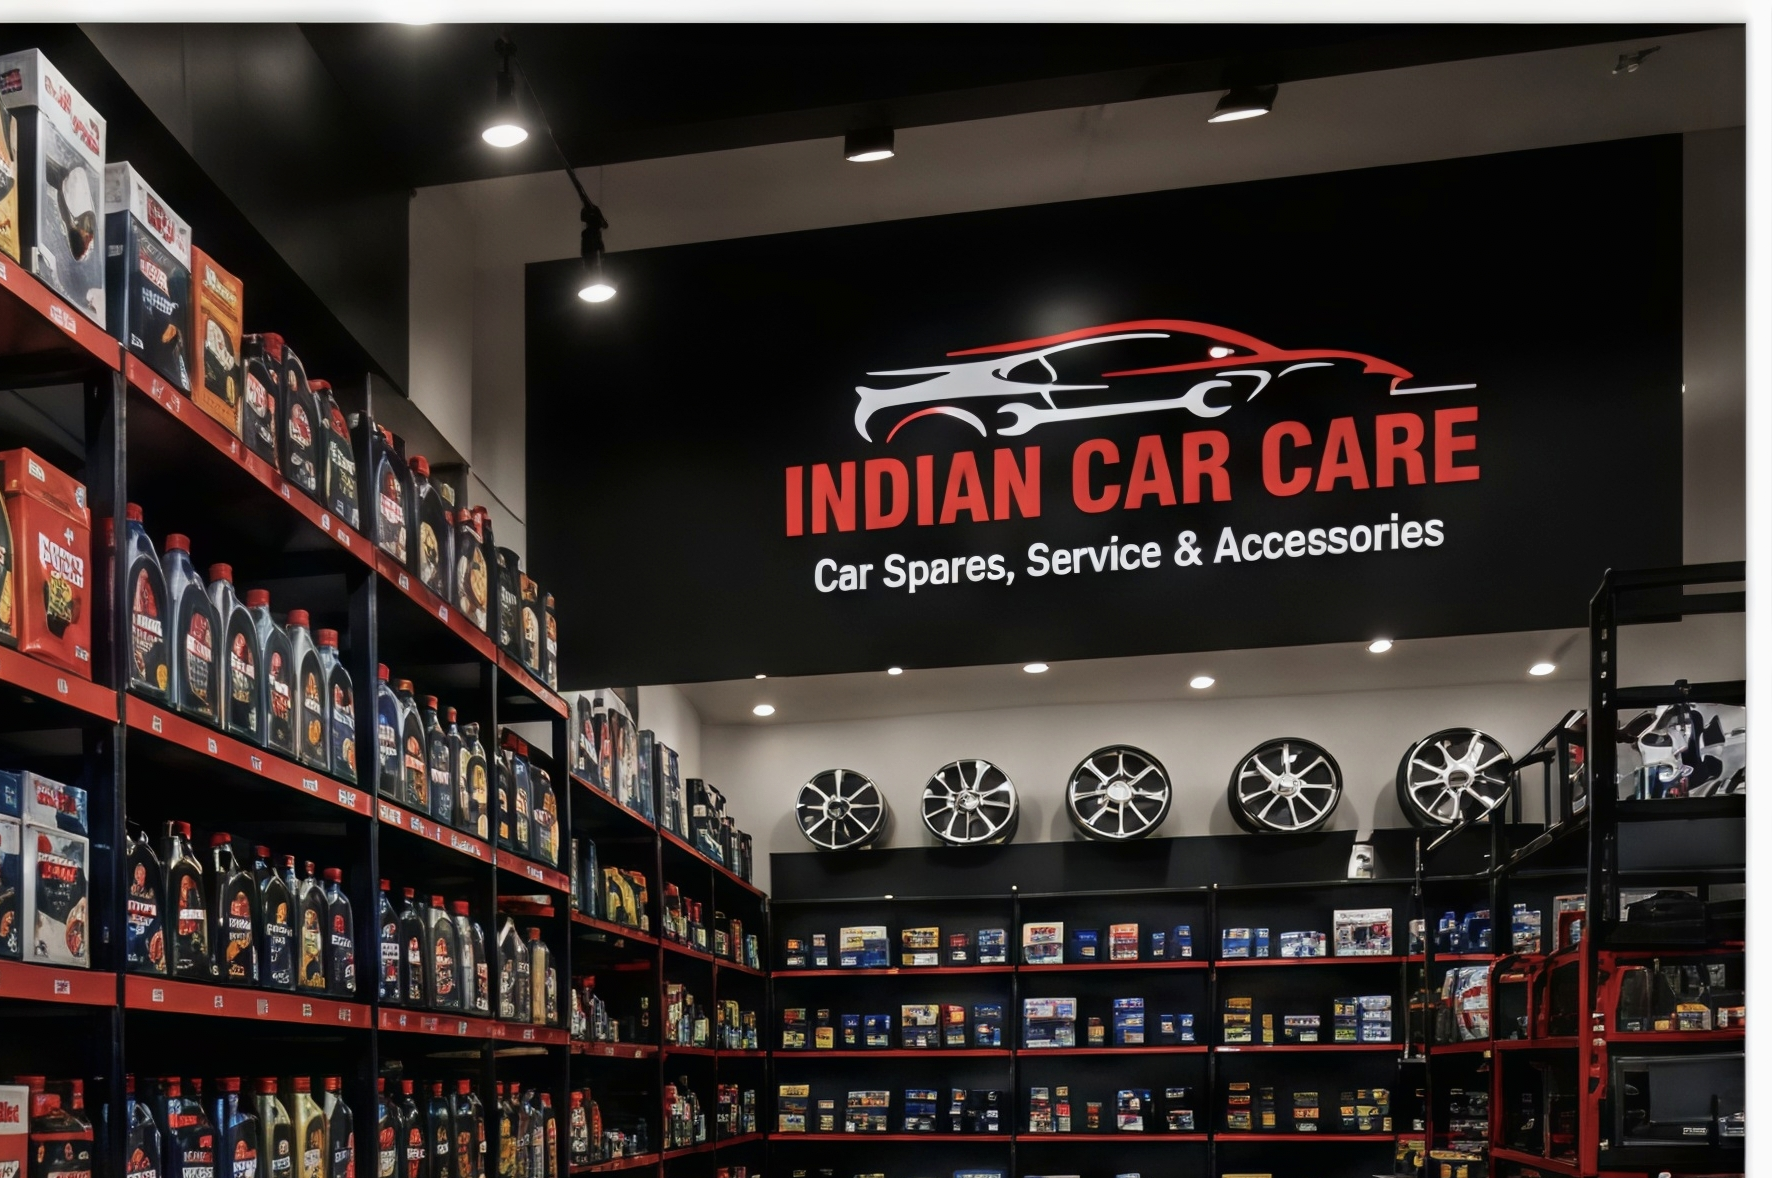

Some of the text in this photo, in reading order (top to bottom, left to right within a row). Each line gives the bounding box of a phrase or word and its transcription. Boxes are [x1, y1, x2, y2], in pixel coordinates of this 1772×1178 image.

[785, 406, 1480, 537] INDIAN CAR CARE
[814, 512, 1445, 595] Car Spares, Service & Accessories
